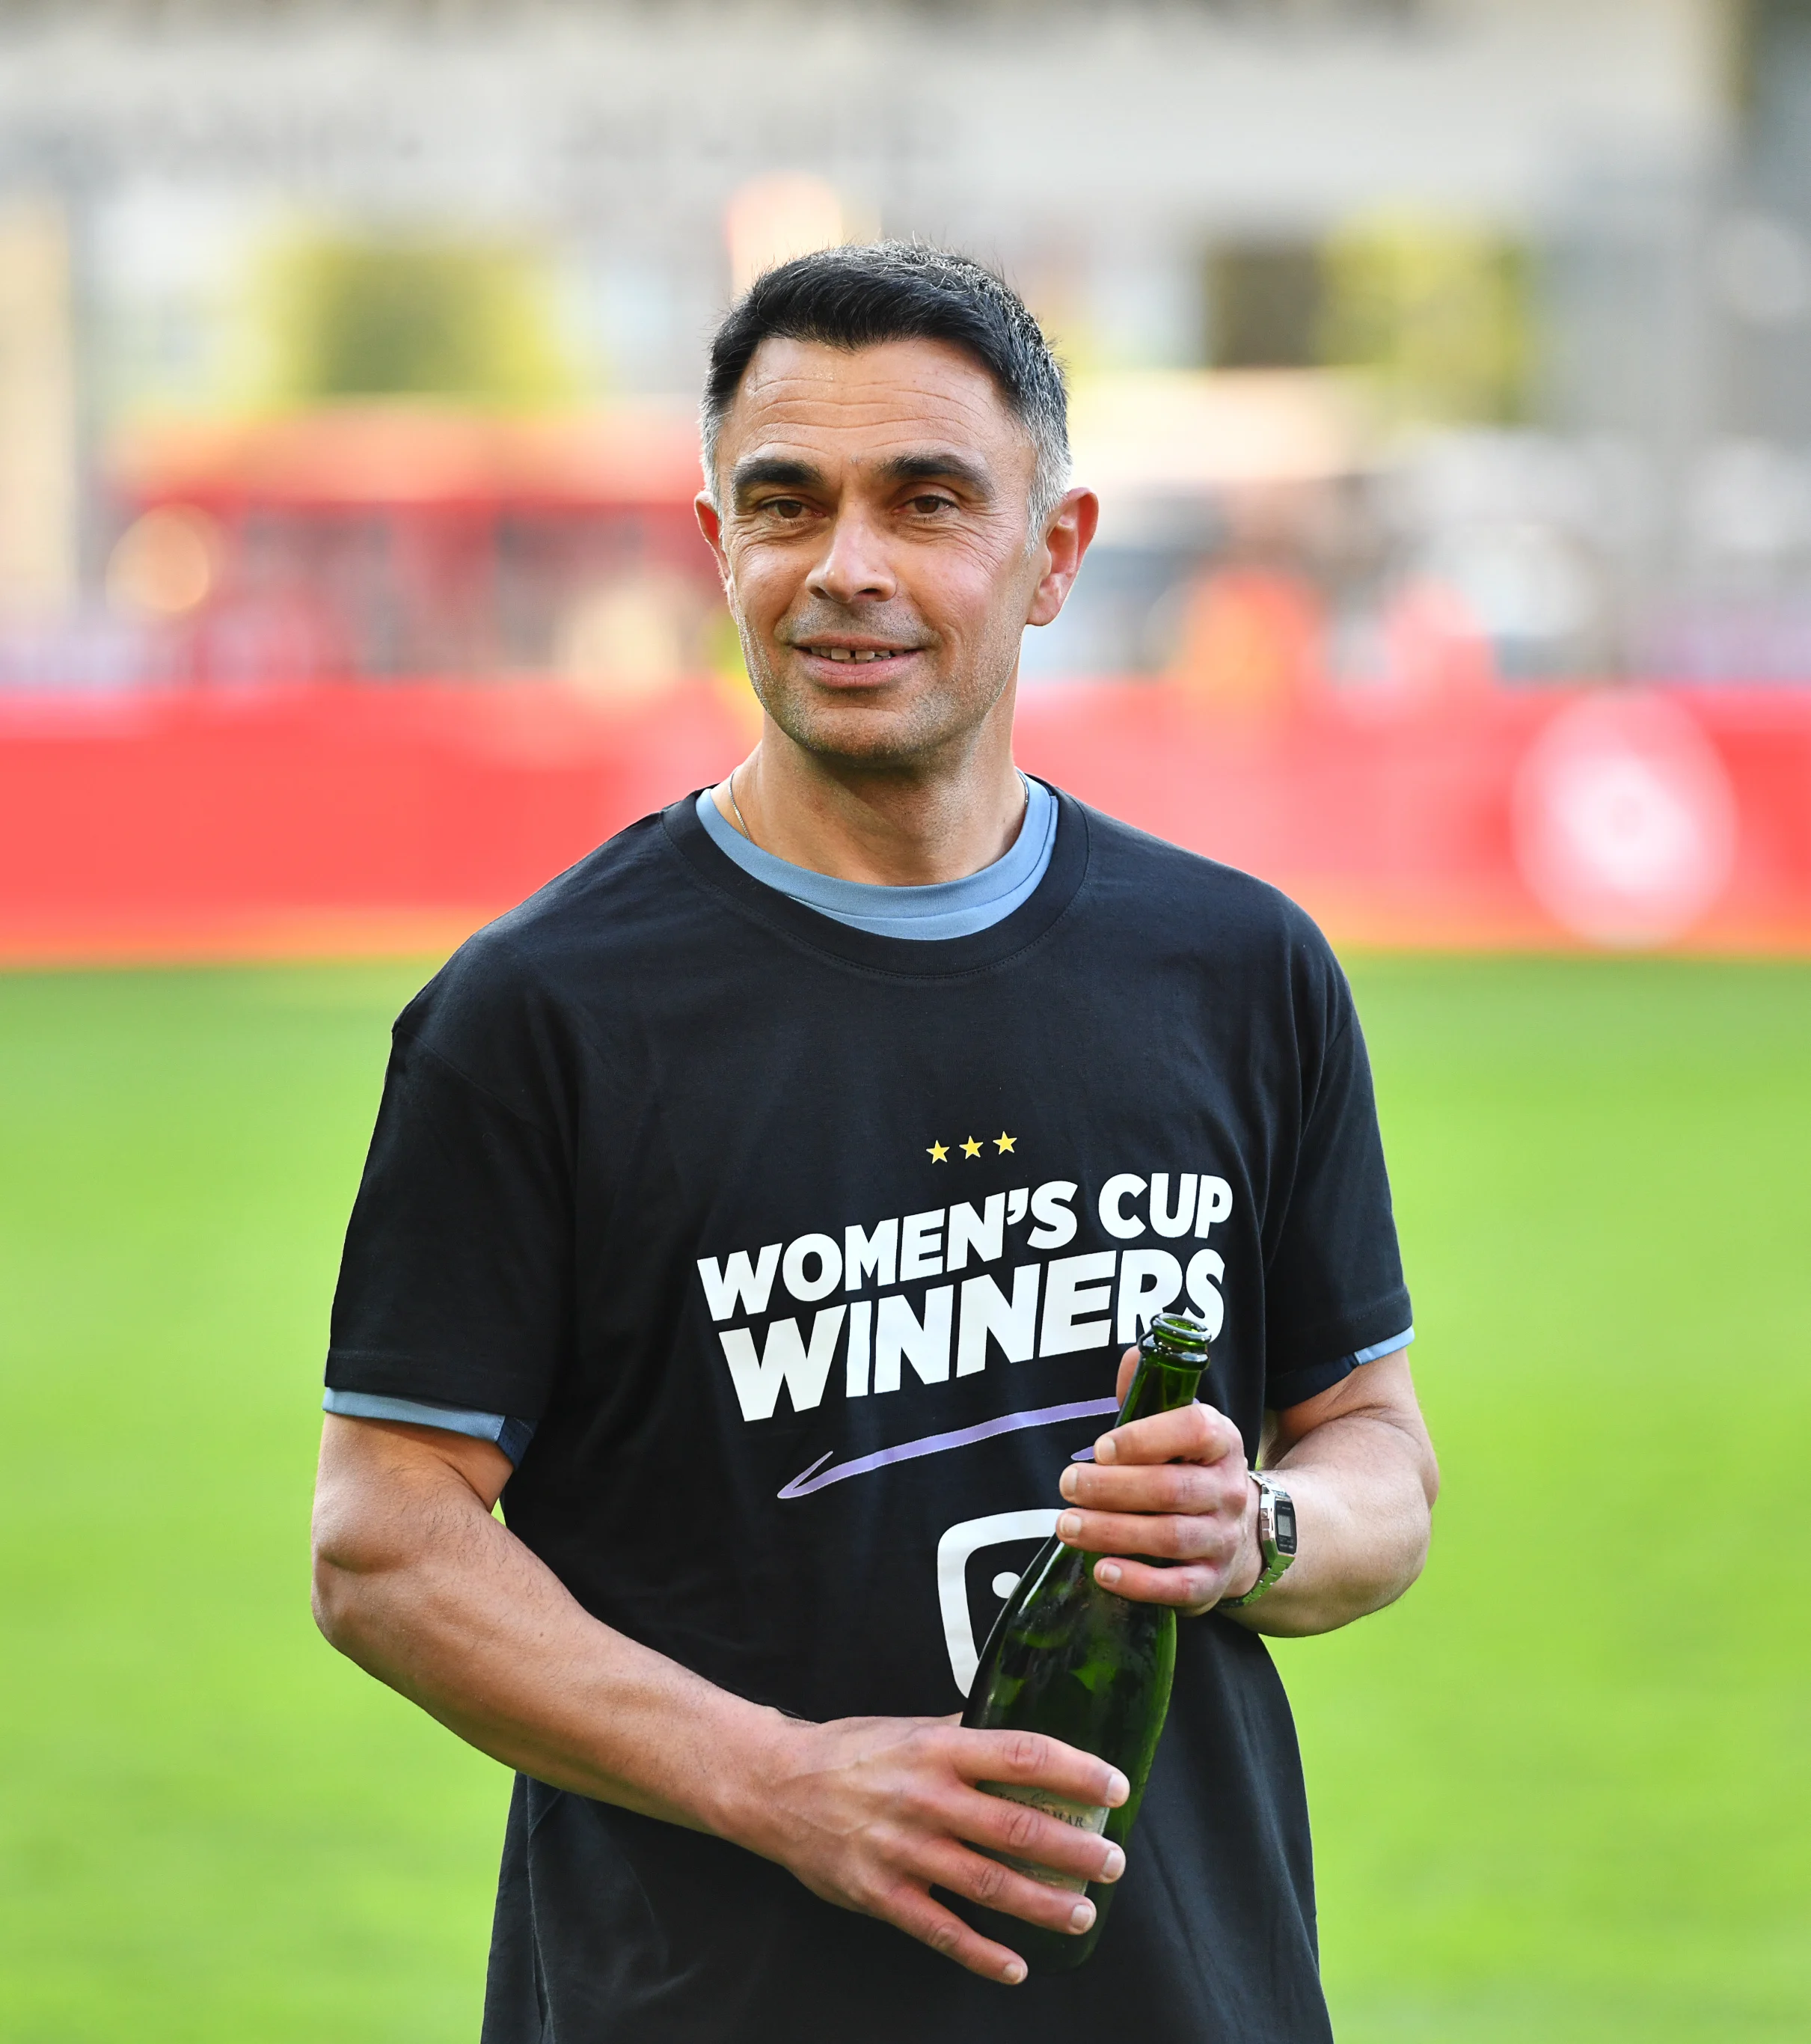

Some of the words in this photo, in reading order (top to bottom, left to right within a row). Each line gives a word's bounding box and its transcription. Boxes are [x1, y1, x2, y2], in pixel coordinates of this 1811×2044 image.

[696, 1181, 1078, 1321] WOMEN'S
[1098, 1173, 1234, 1239] CUP
[718, 1248, 1225, 1422] WINNERS
